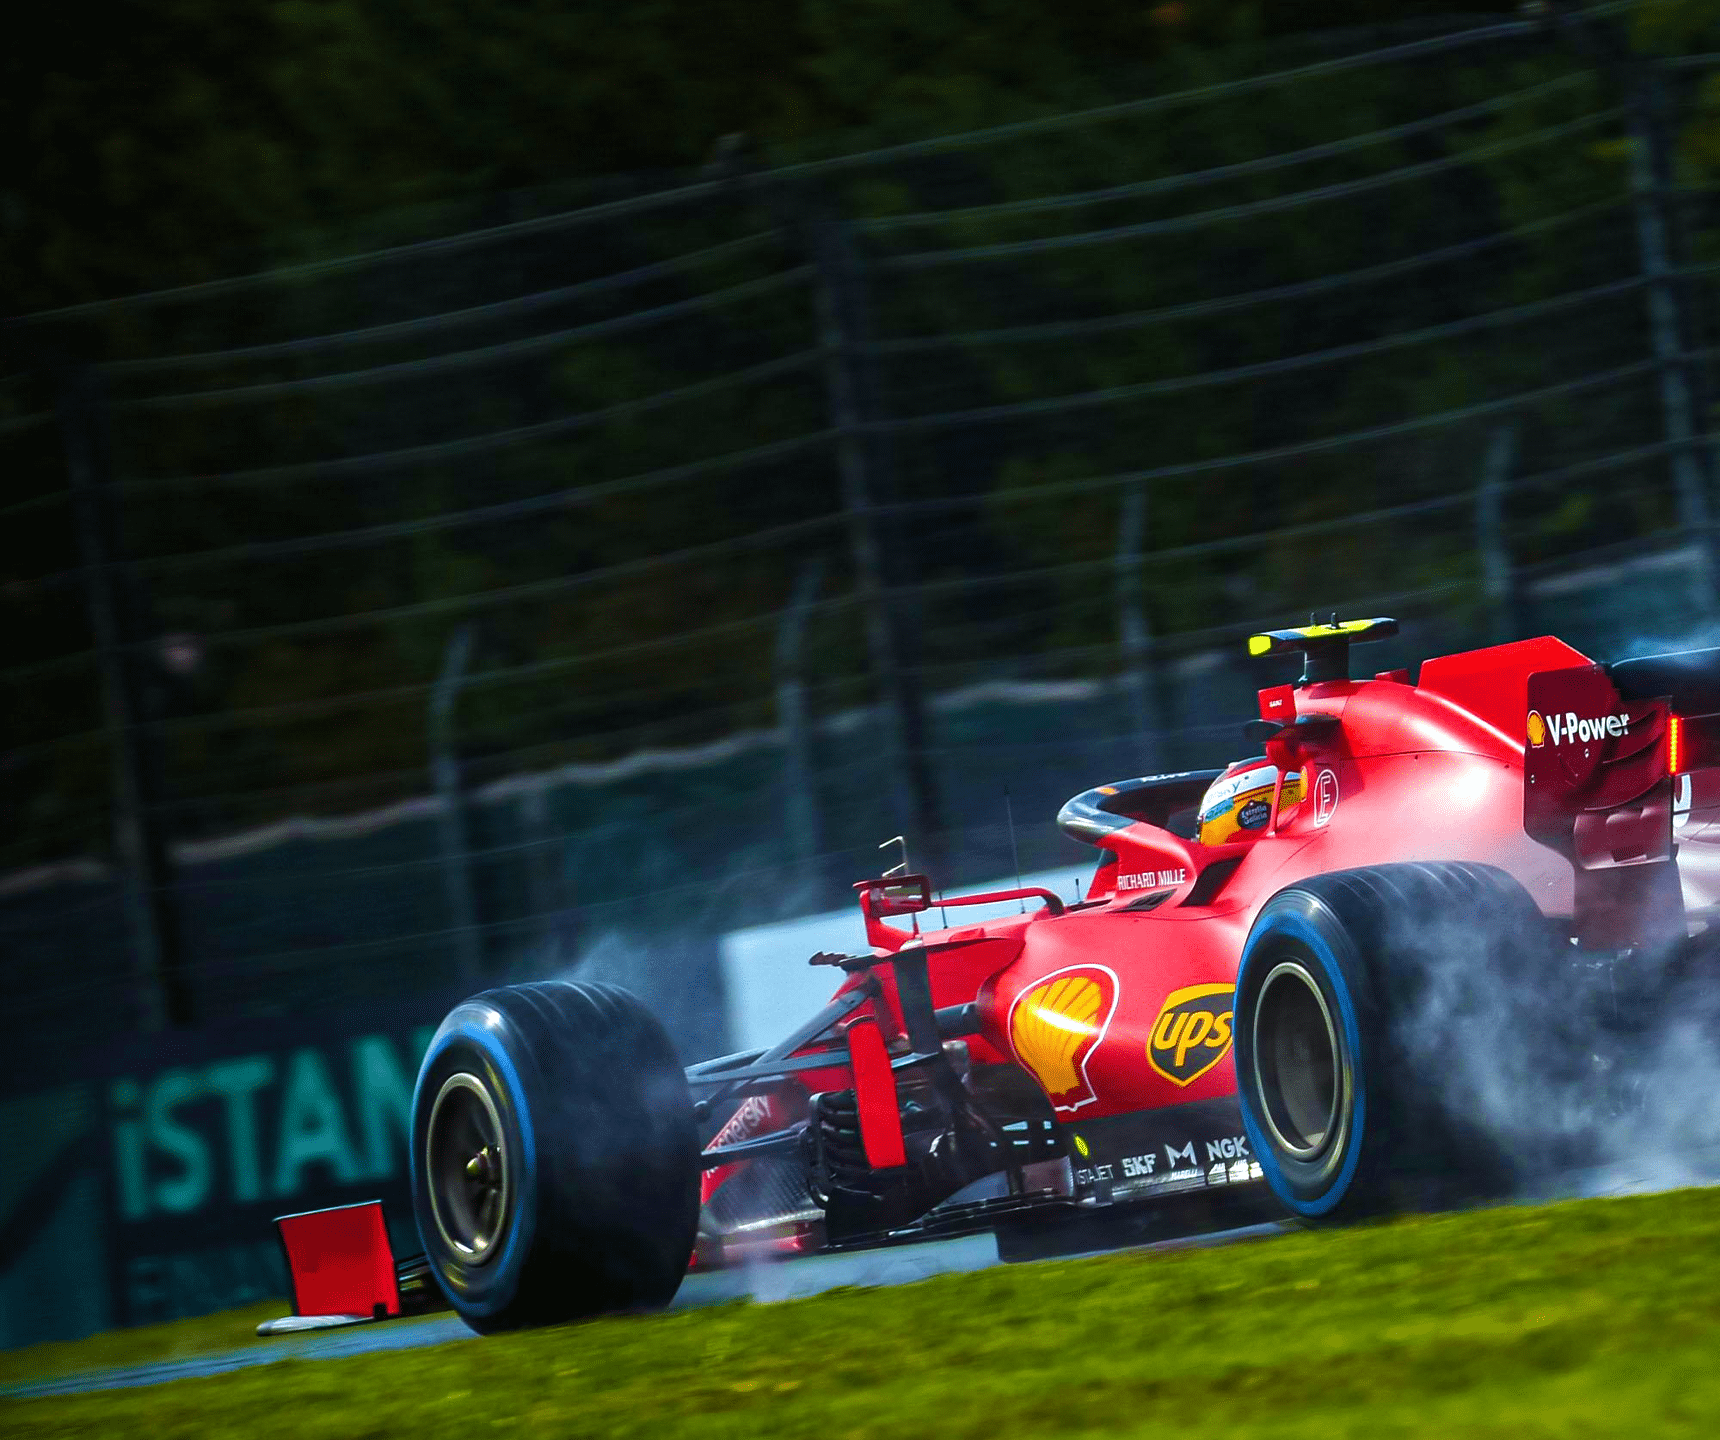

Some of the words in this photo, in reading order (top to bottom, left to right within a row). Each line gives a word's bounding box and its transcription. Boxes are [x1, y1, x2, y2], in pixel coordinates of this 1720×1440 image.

[1546, 712, 1630, 746] V-Power
[1117, 871, 1156, 890] RICHARD
[1158, 868, 1186, 886] MILLE
[1153, 1010, 1234, 1067] ups
[1206, 1135, 1250, 1162] NGK
[1122, 1153, 1157, 1178] SKF
